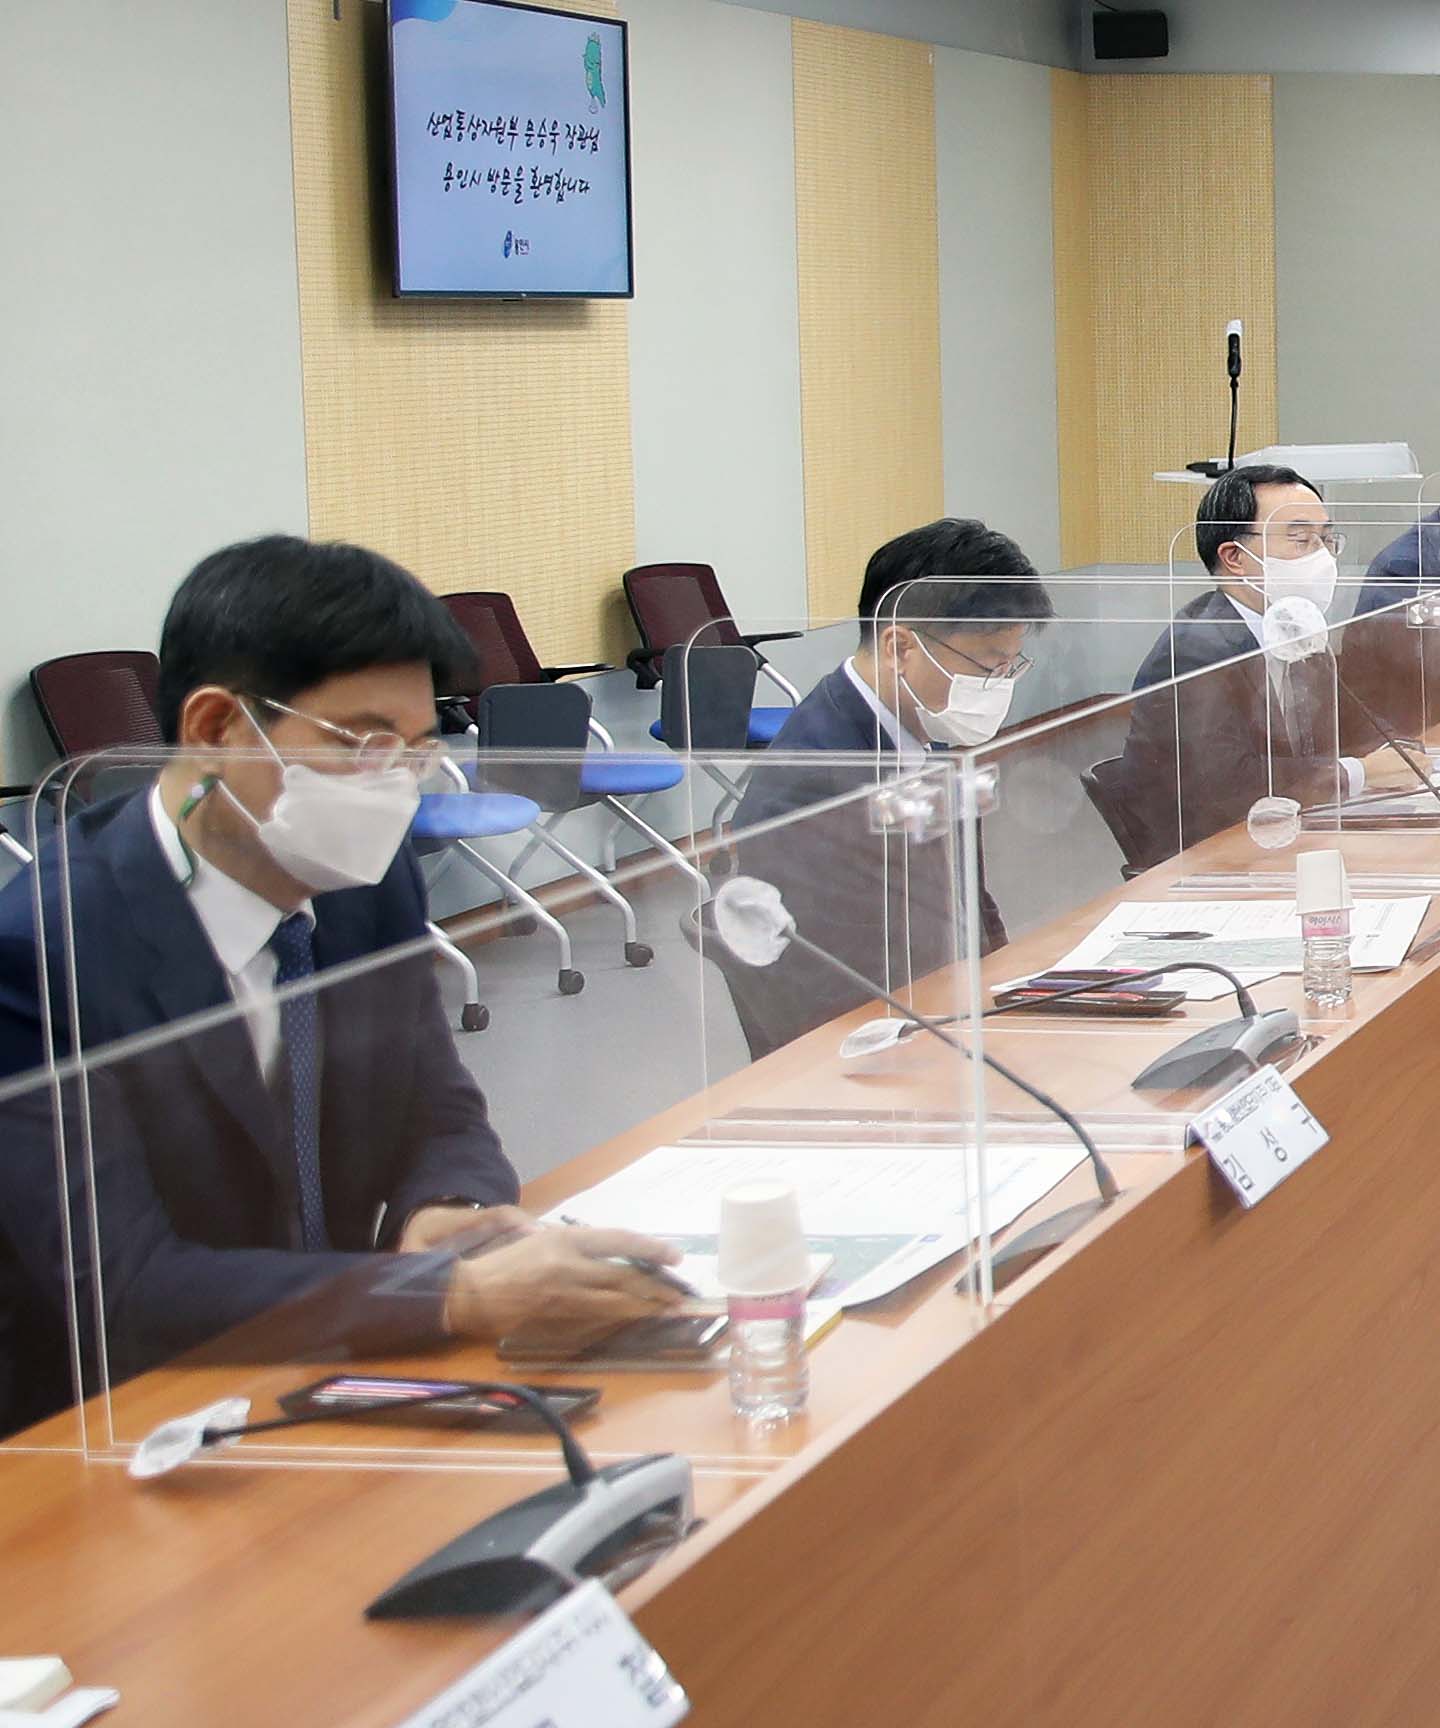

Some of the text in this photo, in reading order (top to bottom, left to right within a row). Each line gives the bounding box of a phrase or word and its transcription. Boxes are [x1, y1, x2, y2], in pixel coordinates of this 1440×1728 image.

[426, 110, 600, 156] 산업통상자원부 문승욱 장관님
[443, 162, 591, 204] 용인시 방문을 환영합니다
